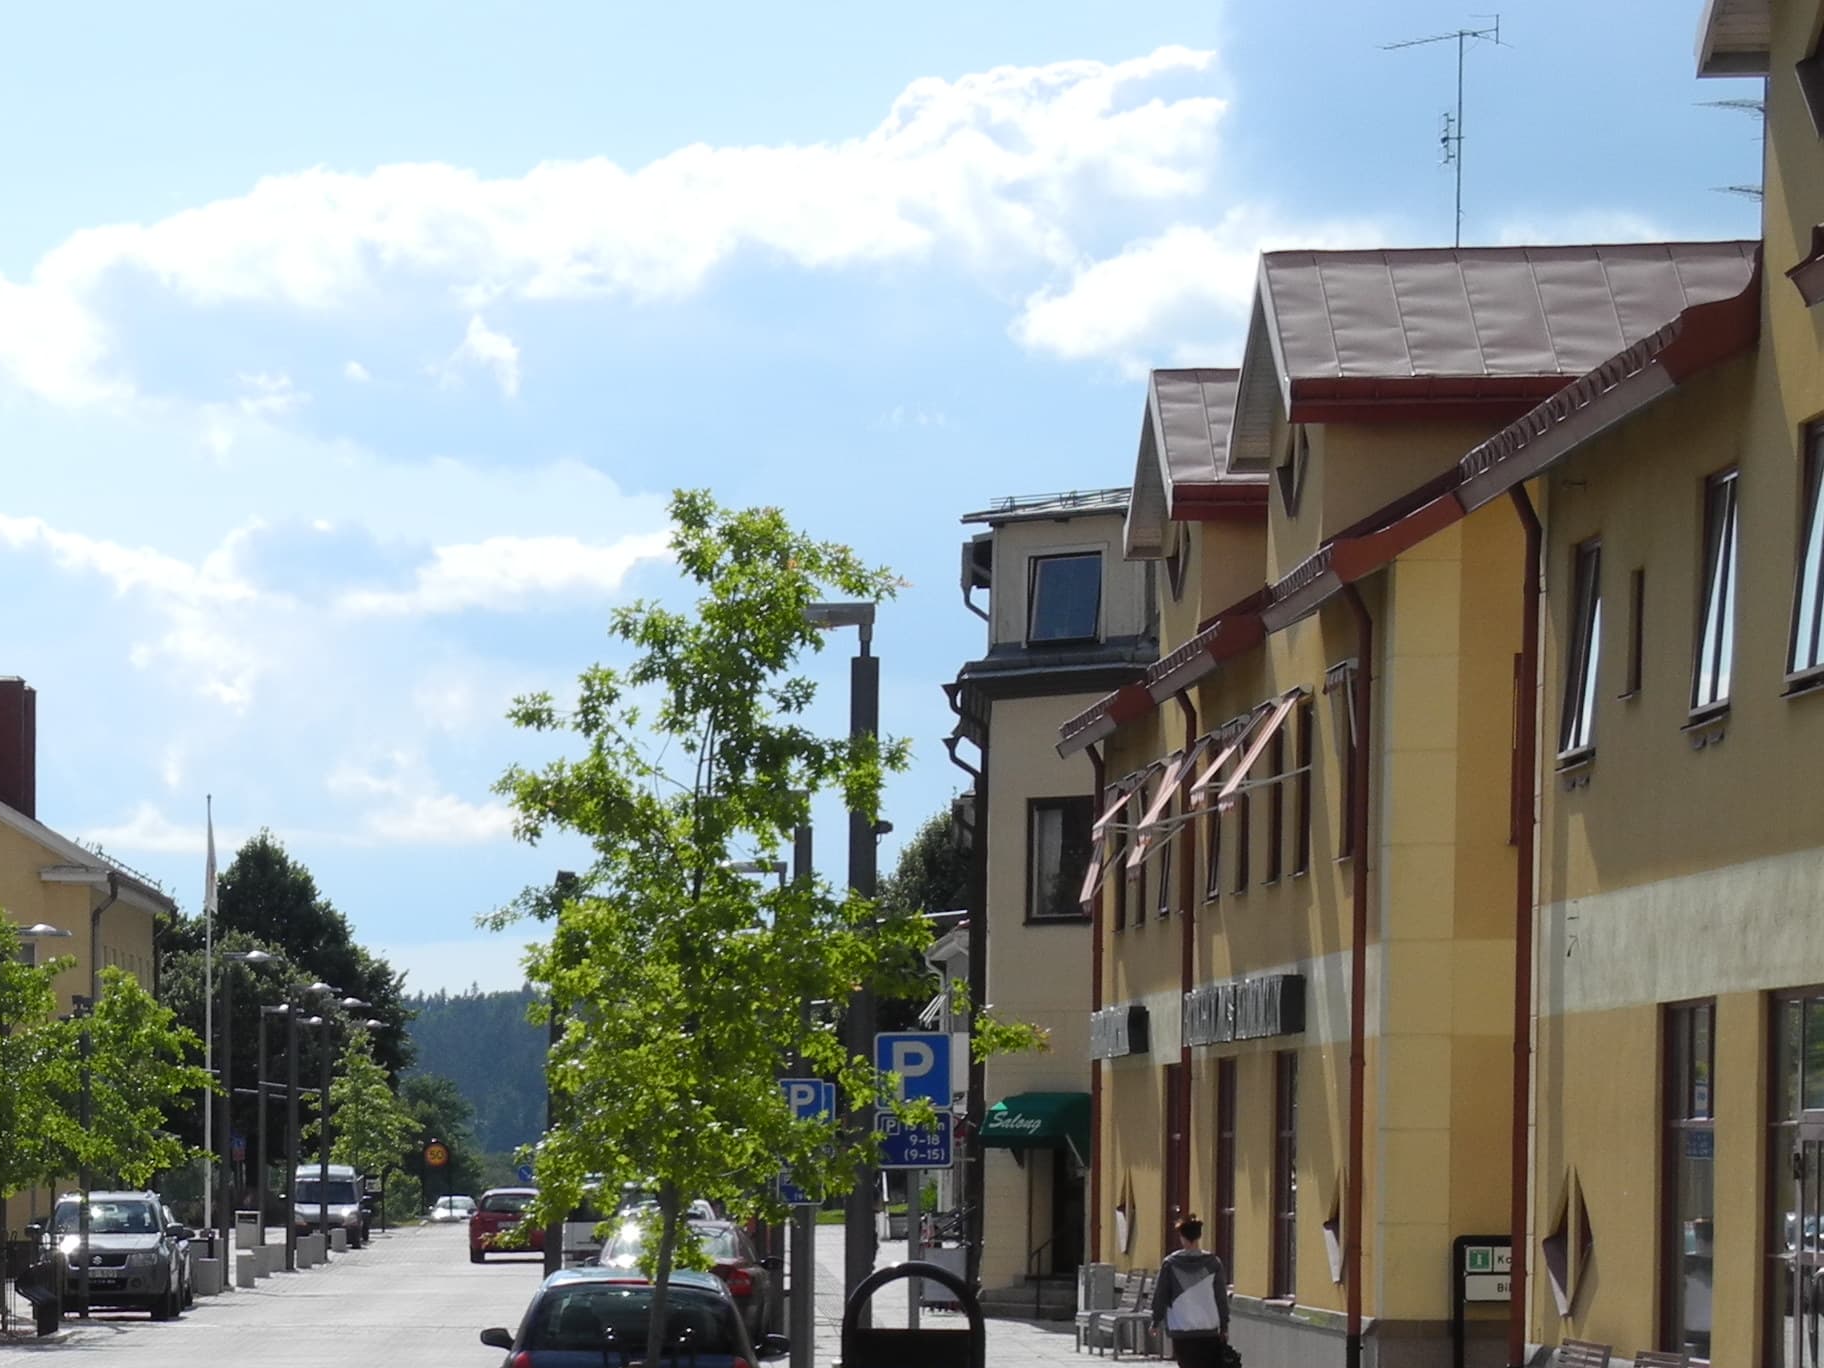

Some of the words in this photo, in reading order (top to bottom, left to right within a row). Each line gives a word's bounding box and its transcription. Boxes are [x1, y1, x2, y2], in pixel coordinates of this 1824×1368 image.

[893, 1041, 935, 1102] P
[790, 1083, 816, 1118] P
[989, 1110, 1042, 1135] Salong
[909, 1134, 941, 1146] 9-18
[904, 1148, 945, 1161] (9-15)
